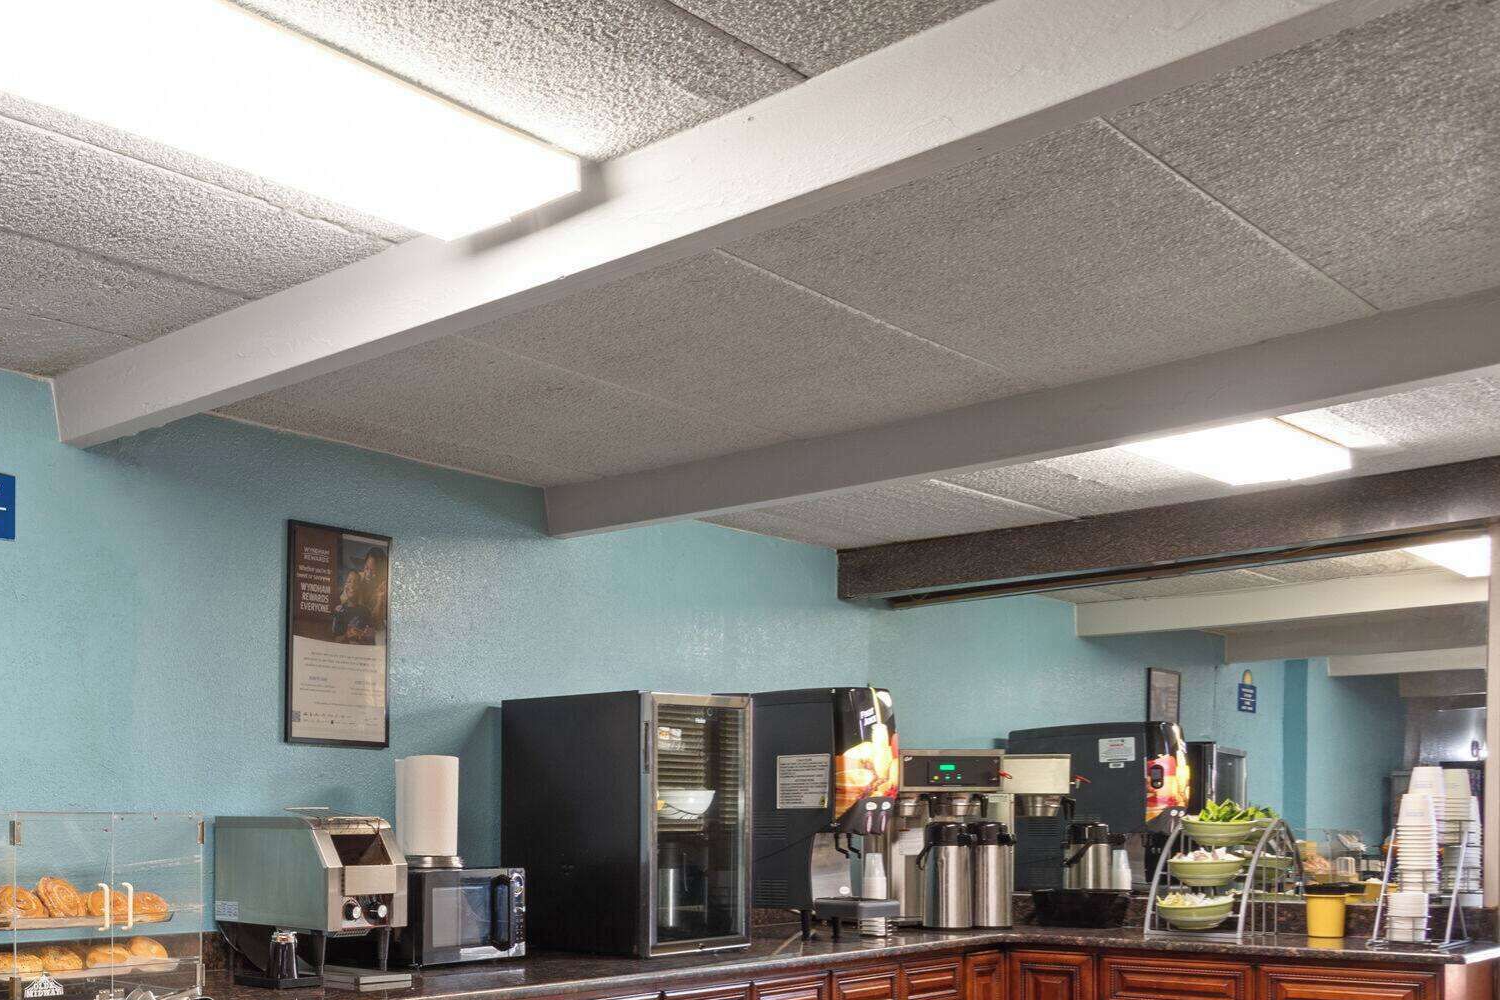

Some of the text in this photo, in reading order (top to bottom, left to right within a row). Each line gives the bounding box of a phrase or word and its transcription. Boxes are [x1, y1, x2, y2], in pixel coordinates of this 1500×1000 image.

[303, 546, 330, 554] WYNDHAM
[303, 554, 329, 563] REWARDS
[300, 582, 331, 594] WYNDHAM
[301, 592, 330, 604] REWARDS
